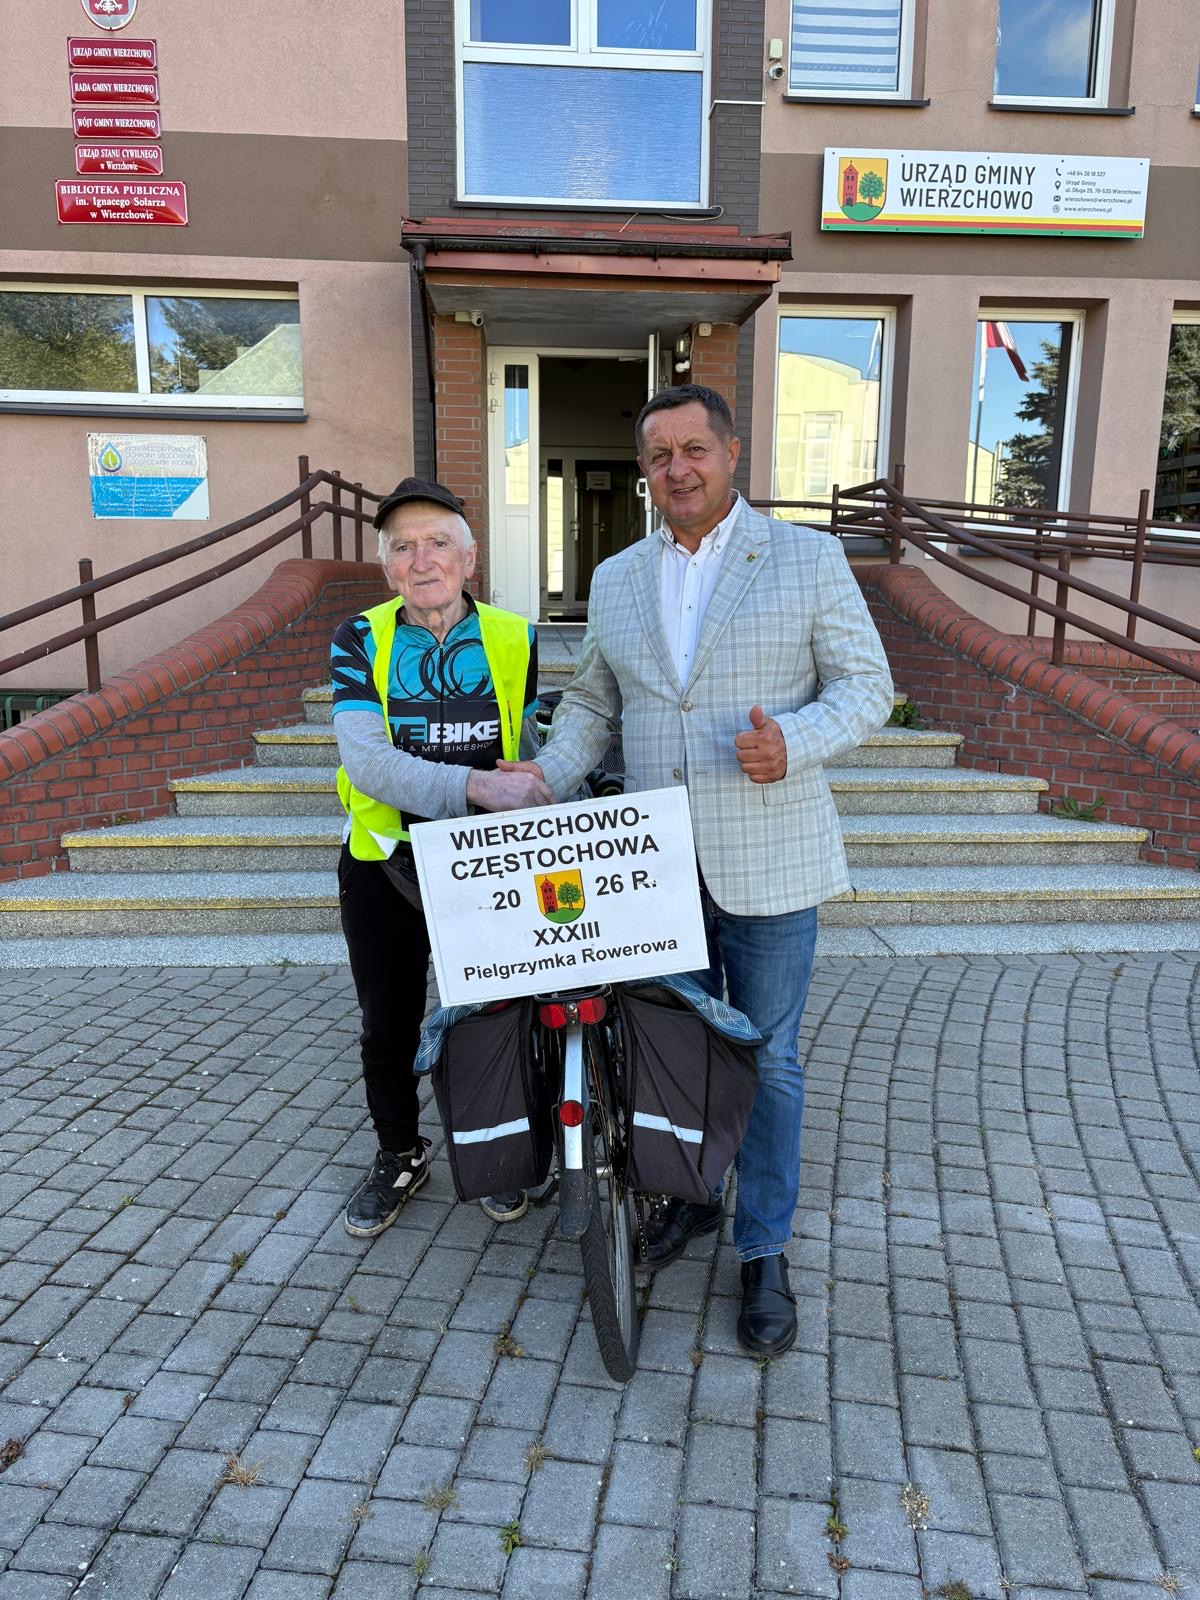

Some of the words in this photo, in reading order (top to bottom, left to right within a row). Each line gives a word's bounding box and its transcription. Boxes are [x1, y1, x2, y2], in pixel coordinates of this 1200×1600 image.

[73, 48, 92, 59] URZĄD
[94, 48, 112, 57] GMINY
[113, 48, 152, 58] WIERZCHOWO
[74, 83, 91, 92] RADA
[92, 83, 111, 92] GMINY
[113, 84, 154, 94] WIERZCHOWO
[78, 116, 92, 127] WÓJT
[94, 118, 113, 127] GMINY
[115, 118, 155, 128] WIERZCHOWO
[79, 148, 99, 160] URZĄD
[101, 149, 120, 158] STANU
[122, 150, 158, 159] CYWILNEGO
[106, 161, 138, 170] Wierzchowie
[900, 162, 967, 188] URZĄD
[974, 164, 1036, 186] GMINY
[60, 185, 119, 194] BIBLIOTEKA
[123, 186, 180, 196] PUBLICZNA
[76, 196, 89, 206] im.
[93, 197, 130, 208] Ignacego
[134, 198, 166, 207] Solarza
[900, 188, 1034, 210] WIERZCHOWO
[90, 211, 97, 219] w
[101, 210, 154, 220] Wierzchowie
[444, 741, 494, 753] BIKESHOP
[450, 806, 650, 850] WIERZCHOWO-
[450, 834, 660, 880] CZĘSTOCHOWA
[492, 889, 521, 911] 20
[595, 874, 624, 896] 26
[632, 870, 658, 890] R.
[533, 920, 601, 947] XXXIII
[464, 953, 577, 981] Pielgrzymka
[582, 939, 678, 964] Rowerowa
